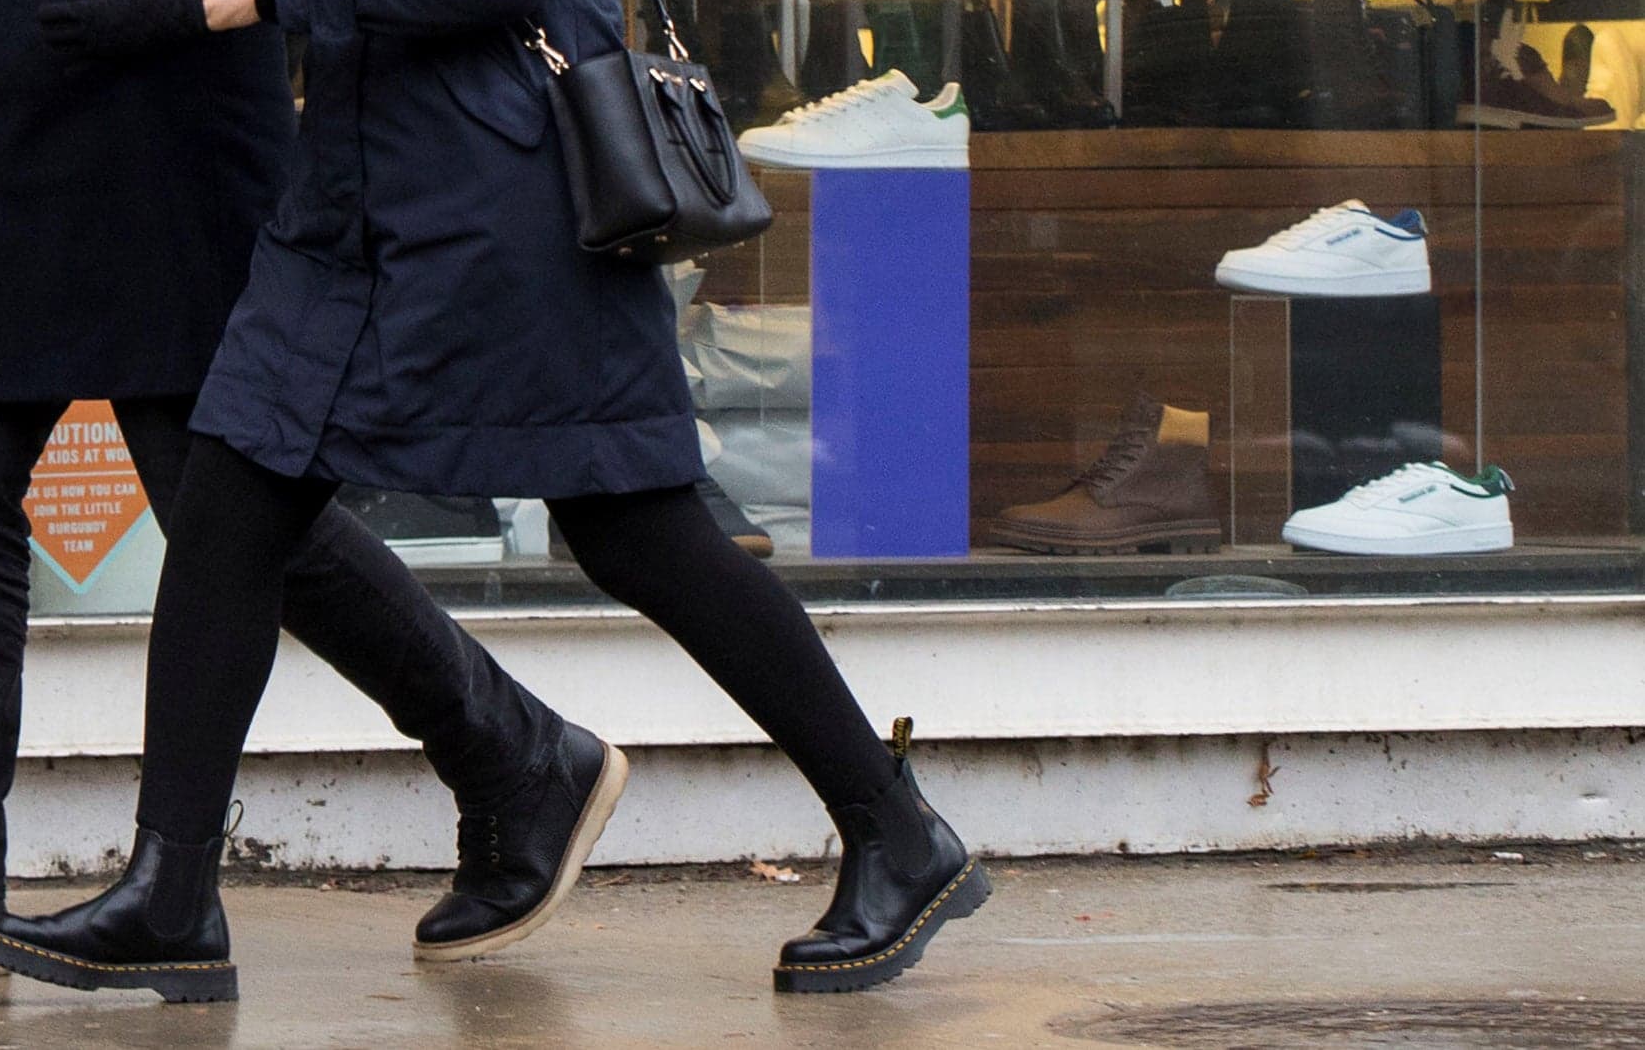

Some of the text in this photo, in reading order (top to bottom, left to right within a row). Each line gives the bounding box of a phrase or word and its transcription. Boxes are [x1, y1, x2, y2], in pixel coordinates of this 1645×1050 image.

[47, 422, 125, 445] AUTION!
[47, 450, 79, 464] KIDS
[84, 448, 100, 463] AT
[43, 486, 58, 498] US
[61, 485, 86, 497] HOW
[89, 484, 111, 496] YOU
[114, 483, 137, 496] CAN
[34, 501, 122, 517] JOIN THE LITTLE
[47, 521, 108, 535] BURGUNDY
[63, 540, 94, 553] TEAM
